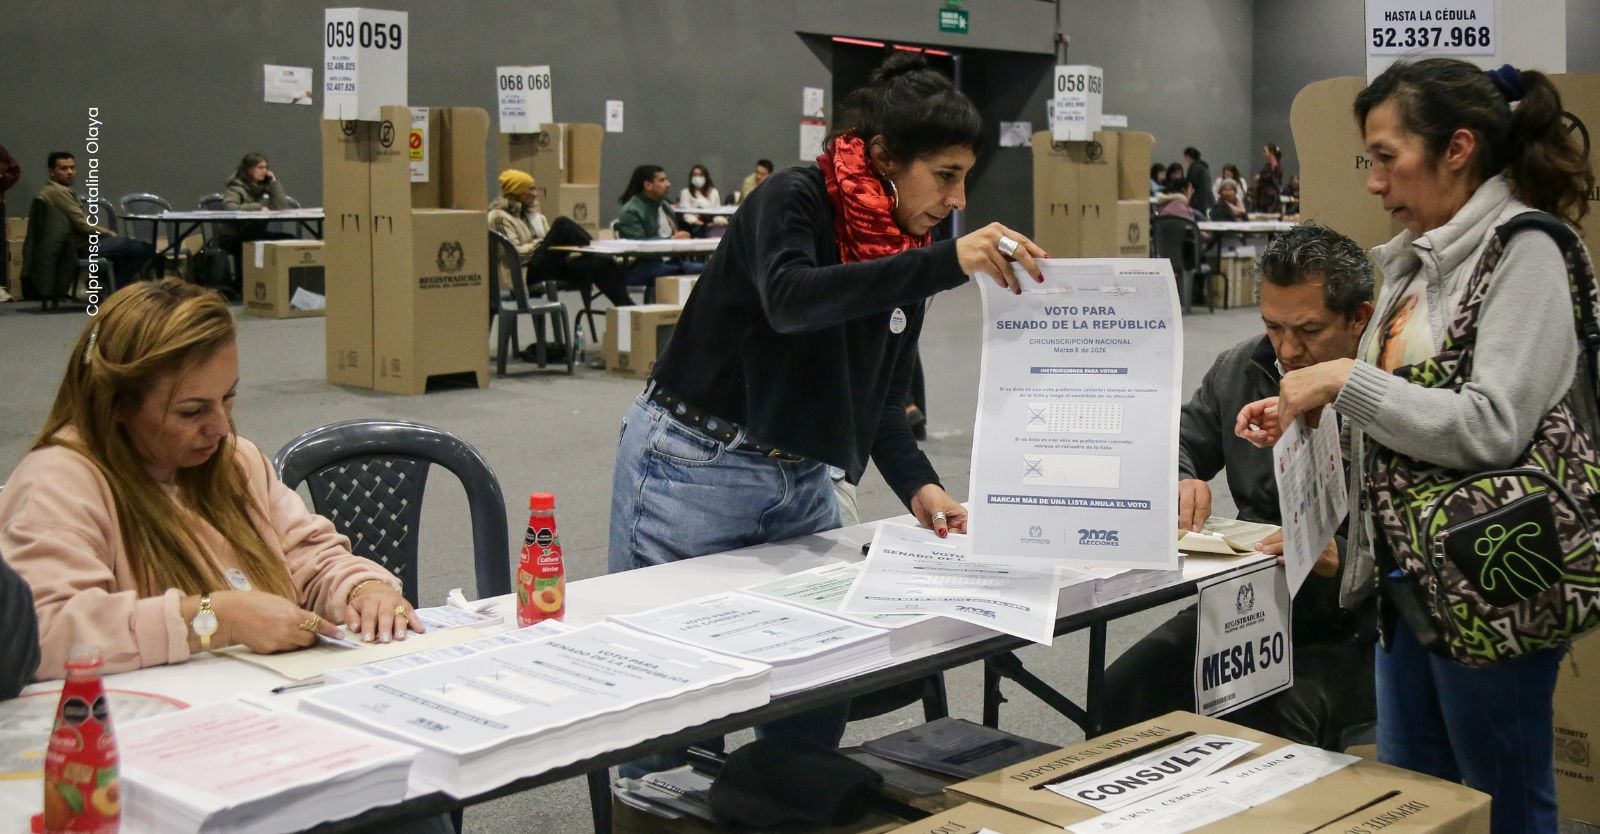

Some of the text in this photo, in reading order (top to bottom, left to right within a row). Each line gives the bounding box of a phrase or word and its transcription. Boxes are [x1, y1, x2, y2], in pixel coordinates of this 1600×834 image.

[1385, 7, 1476, 22] HASTA LA CÉDULA
[327, 21, 354, 48] 059
[359, 21, 402, 50] 059
[1373, 26, 1491, 48] 52.337.968
[500, 75, 524, 91] 068
[528, 74, 551, 90] 068
[1057, 74, 1085, 92] 058
[1088, 75, 1102, 94] 058
[1044, 306, 1116, 316] VOTO PARA
[996, 317, 1167, 330] SENADO DE LA REPÚBLICA
[1029, 337, 1094, 345] CIRCUNSCRIPCIÓN
[990, 496, 1020, 504] MARCAR
[1022, 496, 1038, 504] MÁS
[1039, 497, 1049, 505] DE
[1089, 500, 1115, 508] ANULA
[1127, 501, 1147, 509] VOTO
[1077, 528, 1119, 541] 2026
[1078, 539, 1119, 547] ELECCIONES
[883, 548, 933, 559] SENADO
[932, 551, 965, 559] VOTO
[1203, 631, 1284, 691] MESA 50
[1010, 755, 1082, 782] DEPOSITE
[1078, 748, 1103, 759] SU
[1098, 738, 1138, 752] VOTO
[1077, 738, 1233, 802] CONSULTA
[1120, 807, 1156, 821] URNA
[1161, 785, 1216, 807] CERRADA
[1236, 758, 1286, 779] SELLADA
[1361, 800, 1429, 831] DEPOSITE
